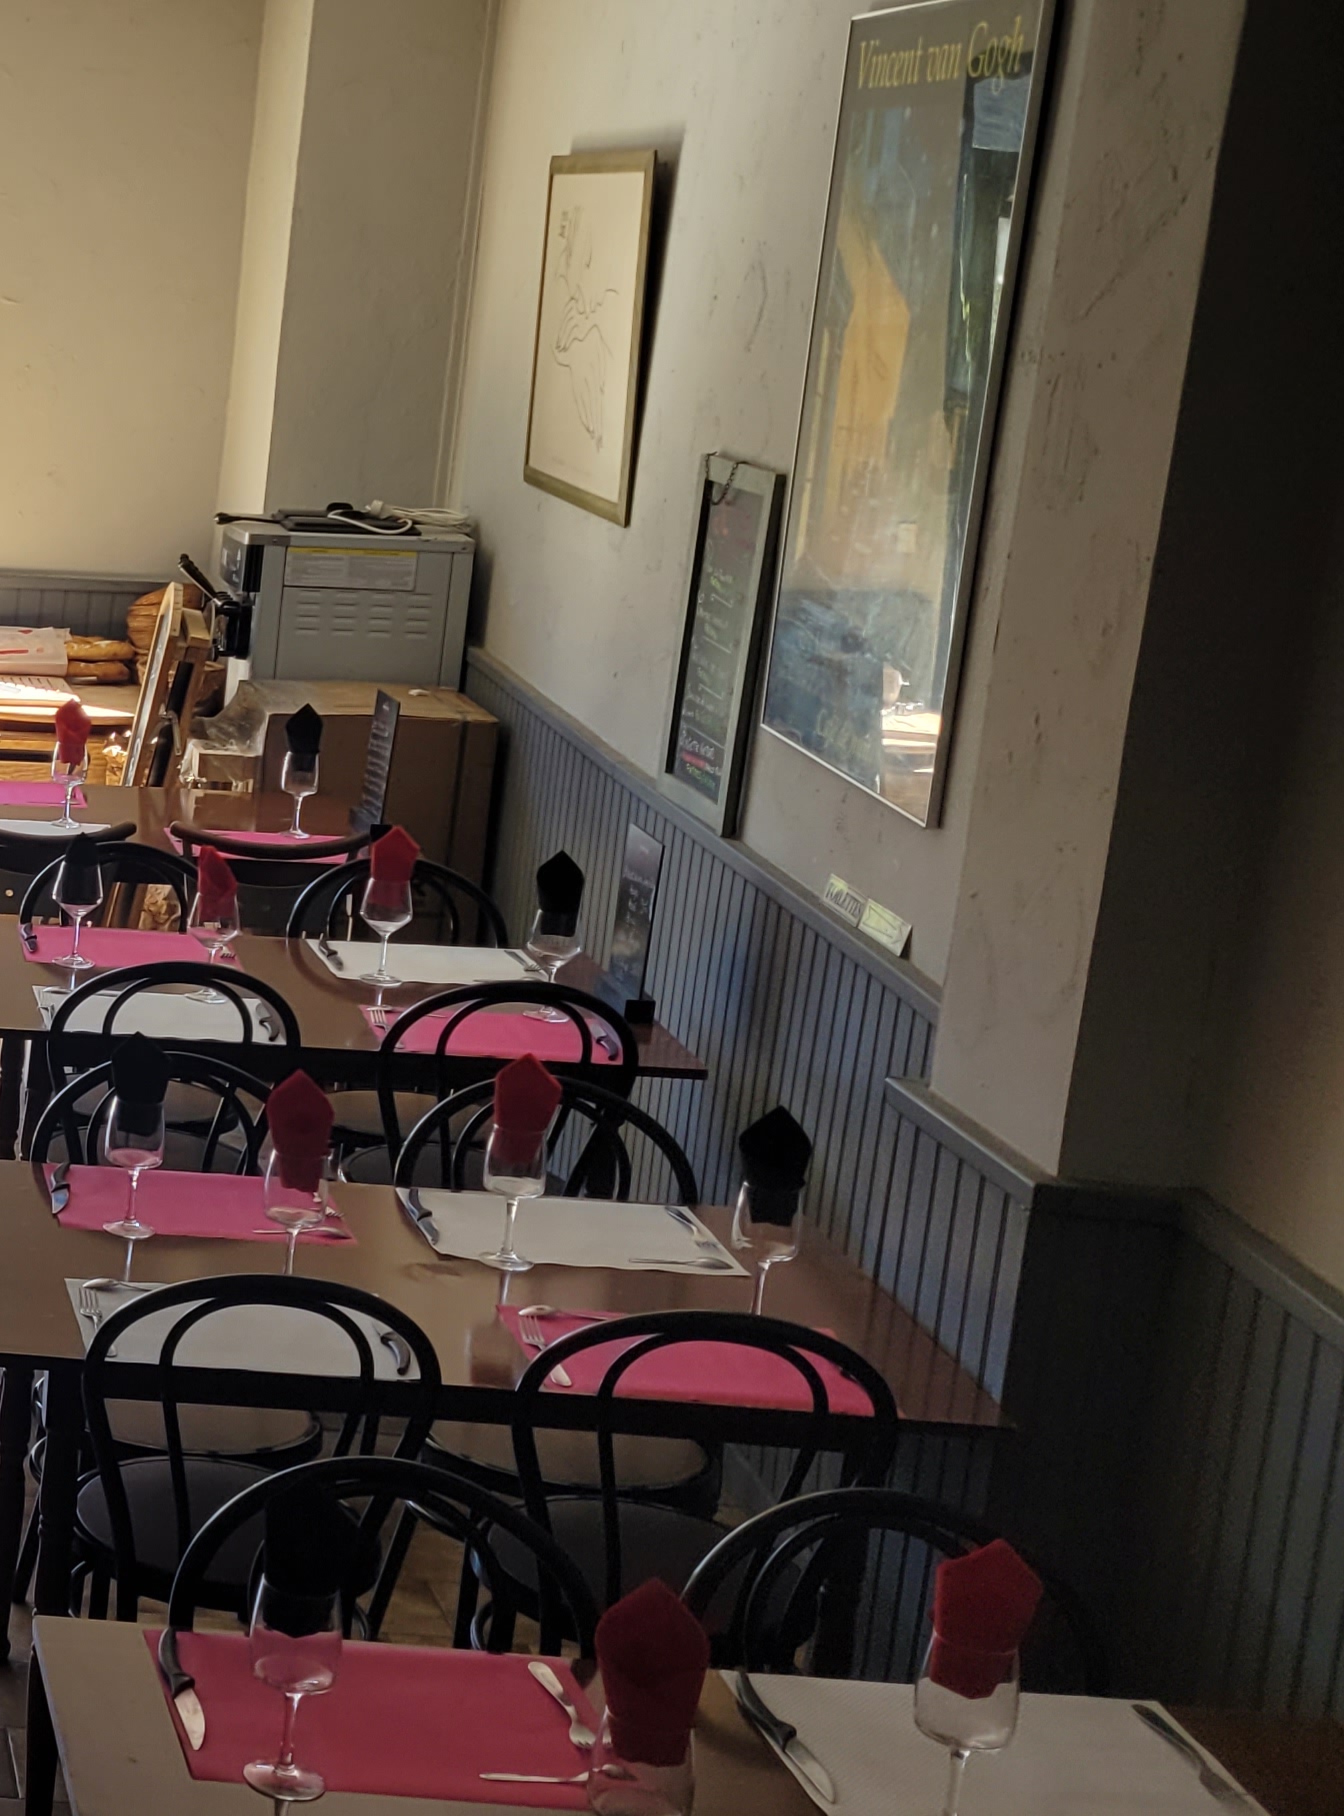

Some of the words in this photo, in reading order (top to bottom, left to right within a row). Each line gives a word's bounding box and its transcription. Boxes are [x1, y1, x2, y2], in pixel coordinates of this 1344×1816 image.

[858, 36, 923, 90] Vincent
[927, 40, 964, 84] van
[967, 15, 1026, 96] Gogh
